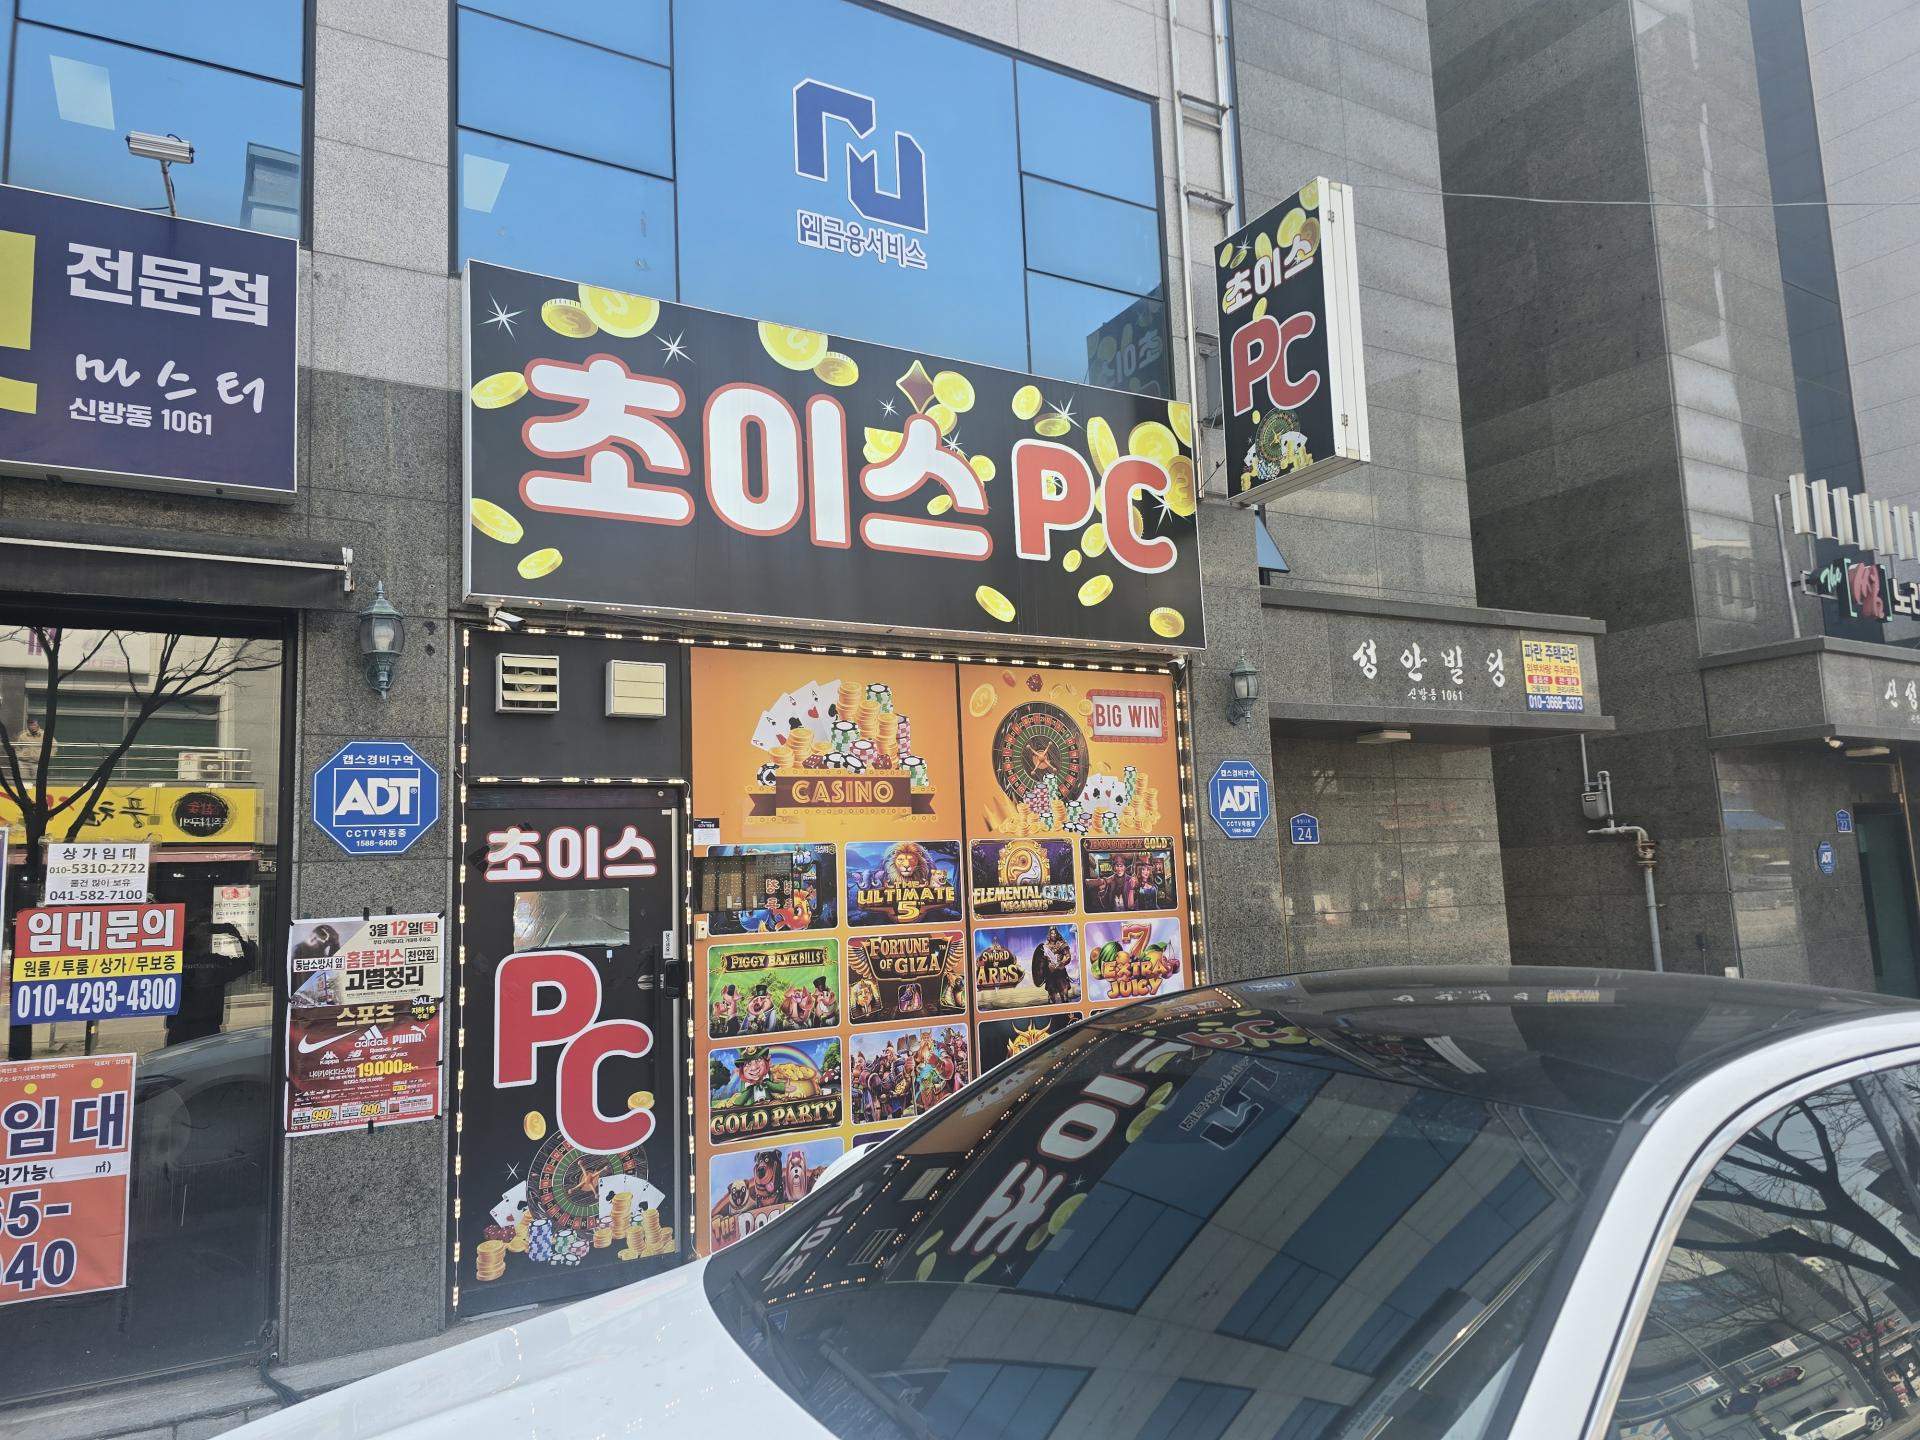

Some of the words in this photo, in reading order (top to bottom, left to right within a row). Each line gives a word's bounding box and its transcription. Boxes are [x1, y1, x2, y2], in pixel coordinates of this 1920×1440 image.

[797, 209, 928, 270] 엠금융서비스
[66, 242, 270, 327] 전문점
[1226, 233, 1314, 314] 초이스
[1231, 311, 1320, 416] PC
[68, 397, 153, 428] 신방동
[160, 408, 213, 435] 1061
[518, 353, 992, 561] 초이스
[1010, 438, 1178, 575] PC
[1408, 687, 1437, 700] 신방동
[1441, 689, 1463, 701] 1061
[1094, 704, 1122, 727] BIG
[1128, 705, 1160, 729] WIN
[342, 754, 414, 765] 캡스경비구역
[335, 777, 419, 815] ADT
[790, 779, 894, 806] CASINO
[1220, 785, 1259, 812] ADT
[1090, 839, 1143, 850] BOUNTY
[1143, 837, 1168, 849] GOLD
[1298, 827, 1313, 841] 24
[484, 824, 657, 883] 초이스
[49, 863, 146, 874] 010-5310-2722
[49, 889, 142, 901] 041-582-7100
[857, 886, 955, 905] ULTIMATE
[973, 885, 1043, 905] ELEMENTAL
[1042, 884, 1076, 901] GEMS
[897, 900, 920, 921] 5
[27, 908, 176, 952] 임대문의
[369, 923, 388, 937] 3월
[1121, 923, 1152, 958] 7
[869, 937, 930, 957] FORTUNE
[982, 950, 1010, 961] SWORD
[294, 958, 333, 971] 동남소방서
[346, 948, 404, 970] 홈플러스
[407, 948, 435, 962] 천안점
[731, 955, 766, 969] PIGGY
[880, 958, 893, 969] OF
[894, 952, 941, 973] GIZA
[1102, 959, 1168, 980] EXTRA
[345, 966, 424, 991] 고별정리
[977, 964, 1020, 985] ARES
[17, 977, 177, 1019] 010-4293-4300
[1107, 977, 1163, 999] JUICY
[412, 997, 435, 1006] SALE
[336, 1004, 394, 1026] 스포츠
[354, 1037, 389, 1048] adidas
[392, 1033, 422, 1044] PUMA
[493, 949, 657, 1156] PC
[710, 1110, 768, 1136] GOLD
[773, 1100, 838, 1127] PARTY
[711, 1217, 737, 1244] THE
